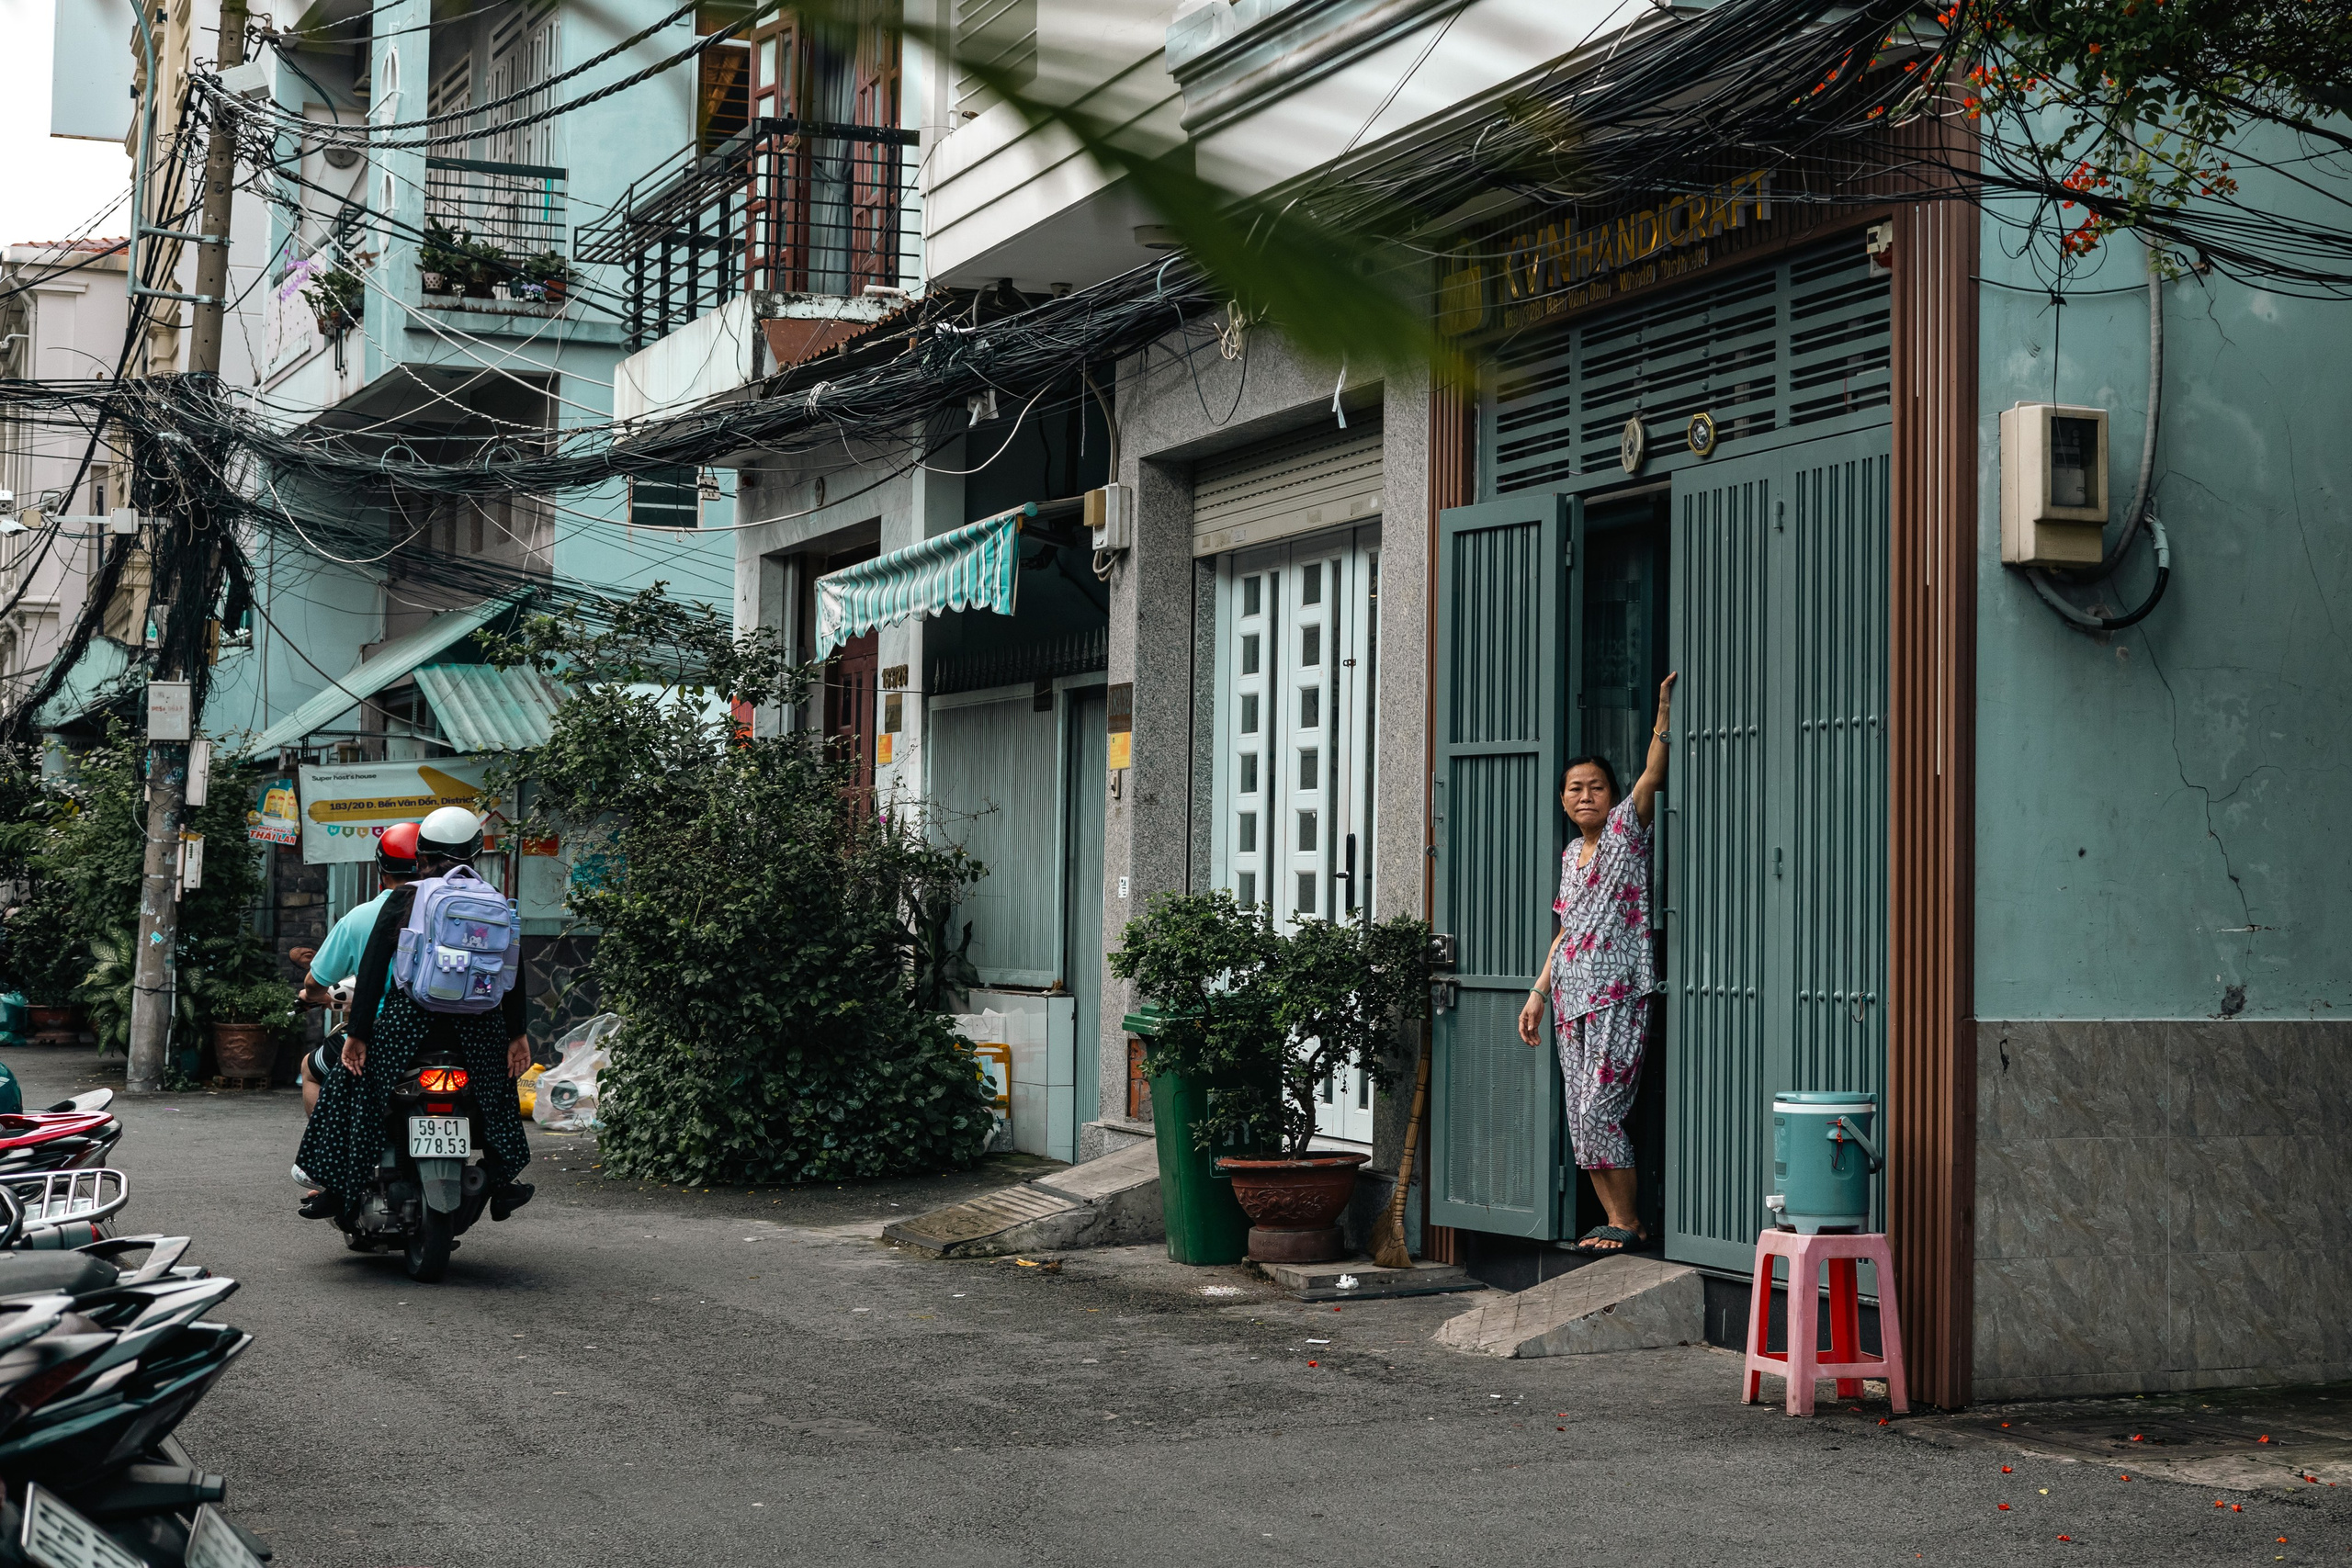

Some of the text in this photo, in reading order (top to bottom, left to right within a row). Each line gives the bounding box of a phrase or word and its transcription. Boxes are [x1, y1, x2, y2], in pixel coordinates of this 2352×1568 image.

[330, 801, 365, 812] 183/20
[441, 795, 475, 805] District
[277, 834, 297, 844] LAN
[330, 827, 382, 836] WELC
[419, 1120, 458, 1136] 59-C1
[413, 1138, 467, 1155] 778.53
